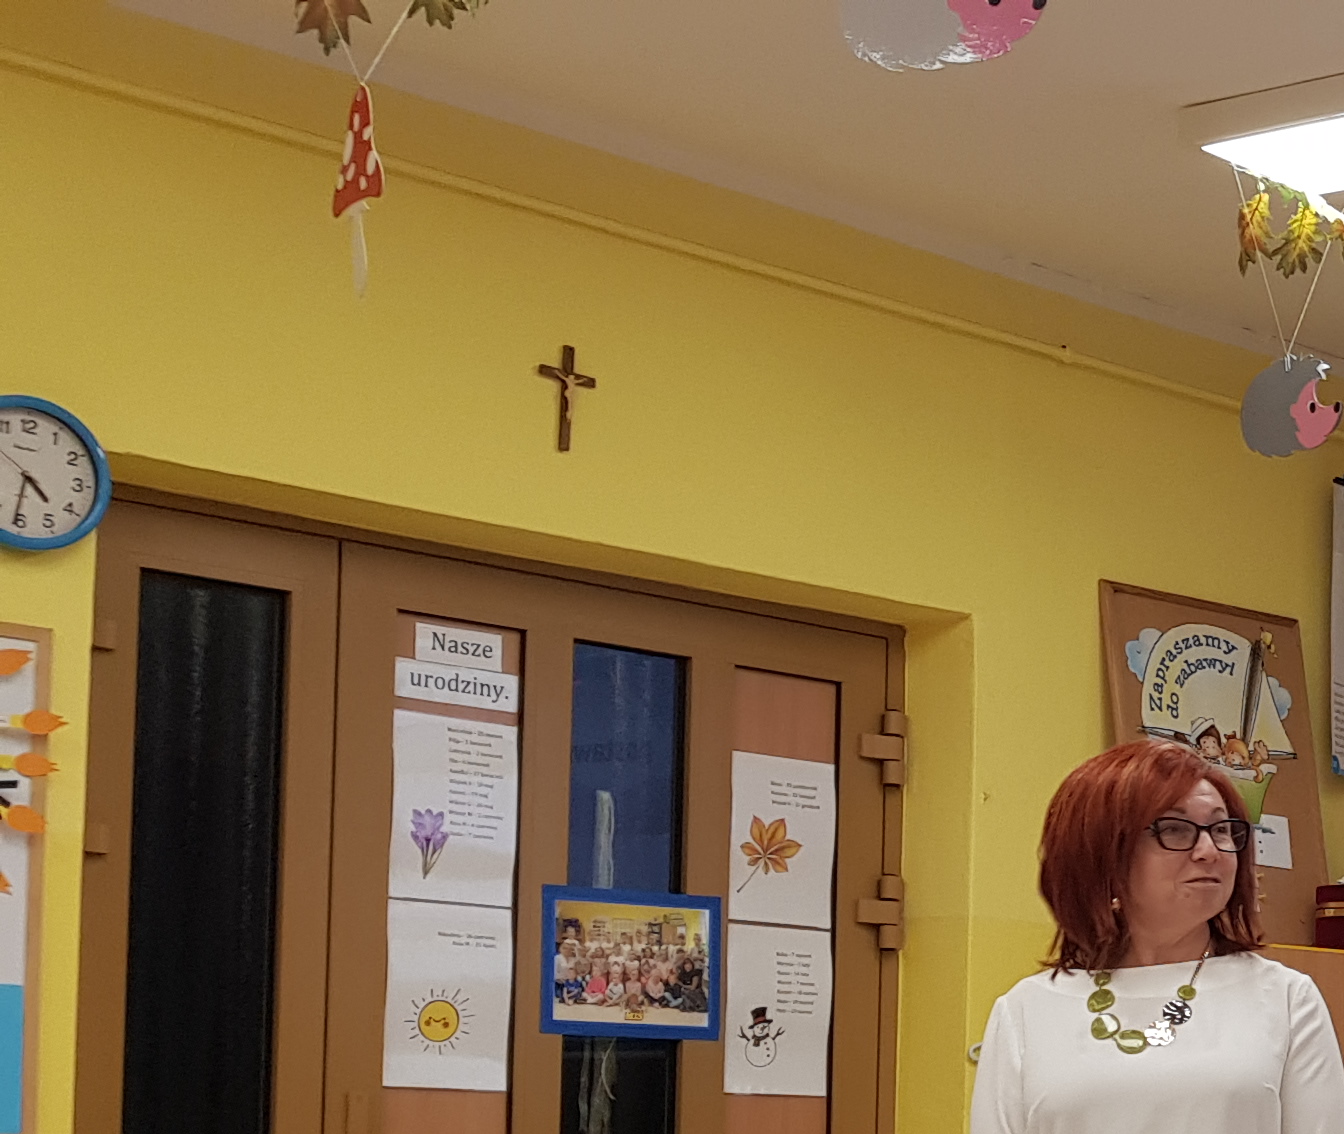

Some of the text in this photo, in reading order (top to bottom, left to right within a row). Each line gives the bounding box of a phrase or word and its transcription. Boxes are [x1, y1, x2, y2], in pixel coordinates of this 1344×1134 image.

[20, 419, 38, 435] 12
[431, 631, 493, 659] Nasze
[410, 671, 510, 703] urodziny.
[1148, 634, 1239, 713] Zapraszamy
[1166, 691, 1180, 720] do
